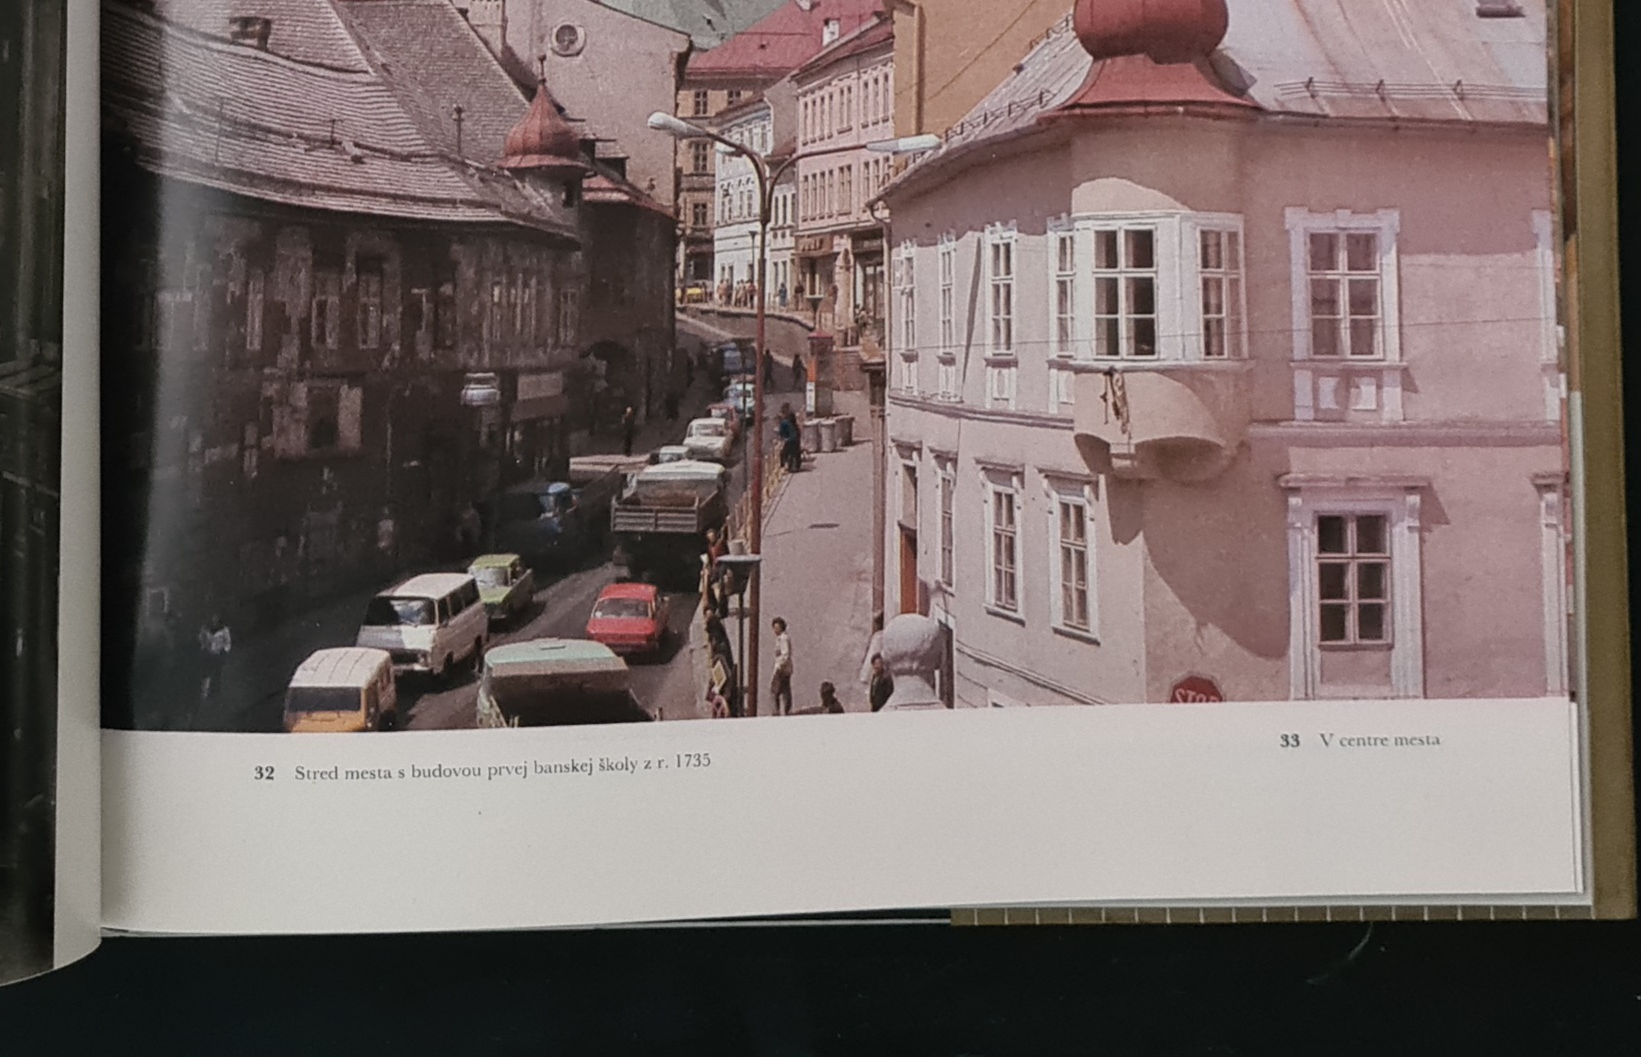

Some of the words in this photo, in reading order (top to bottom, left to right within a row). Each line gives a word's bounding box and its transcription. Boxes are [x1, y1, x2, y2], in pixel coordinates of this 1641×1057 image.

[1279, 732, 1301, 749] 33
[1318, 732, 1335, 748] V
[1338, 736, 1390, 748] centre
[1393, 734, 1441, 747] mesta
[253, 765, 276, 781] 32
[294, 765, 339, 781] Stred
[344, 768, 393, 781] mesta
[397, 768, 406, 780] s
[411, 762, 482, 780] budovou
[487, 760, 528, 781] prvej
[533, 757, 594, 777] banskej
[598, 755, 638, 775] školy
[643, 759, 653, 771] z
[657, 758, 670, 770] r.
[675, 752, 712, 769] 1735
